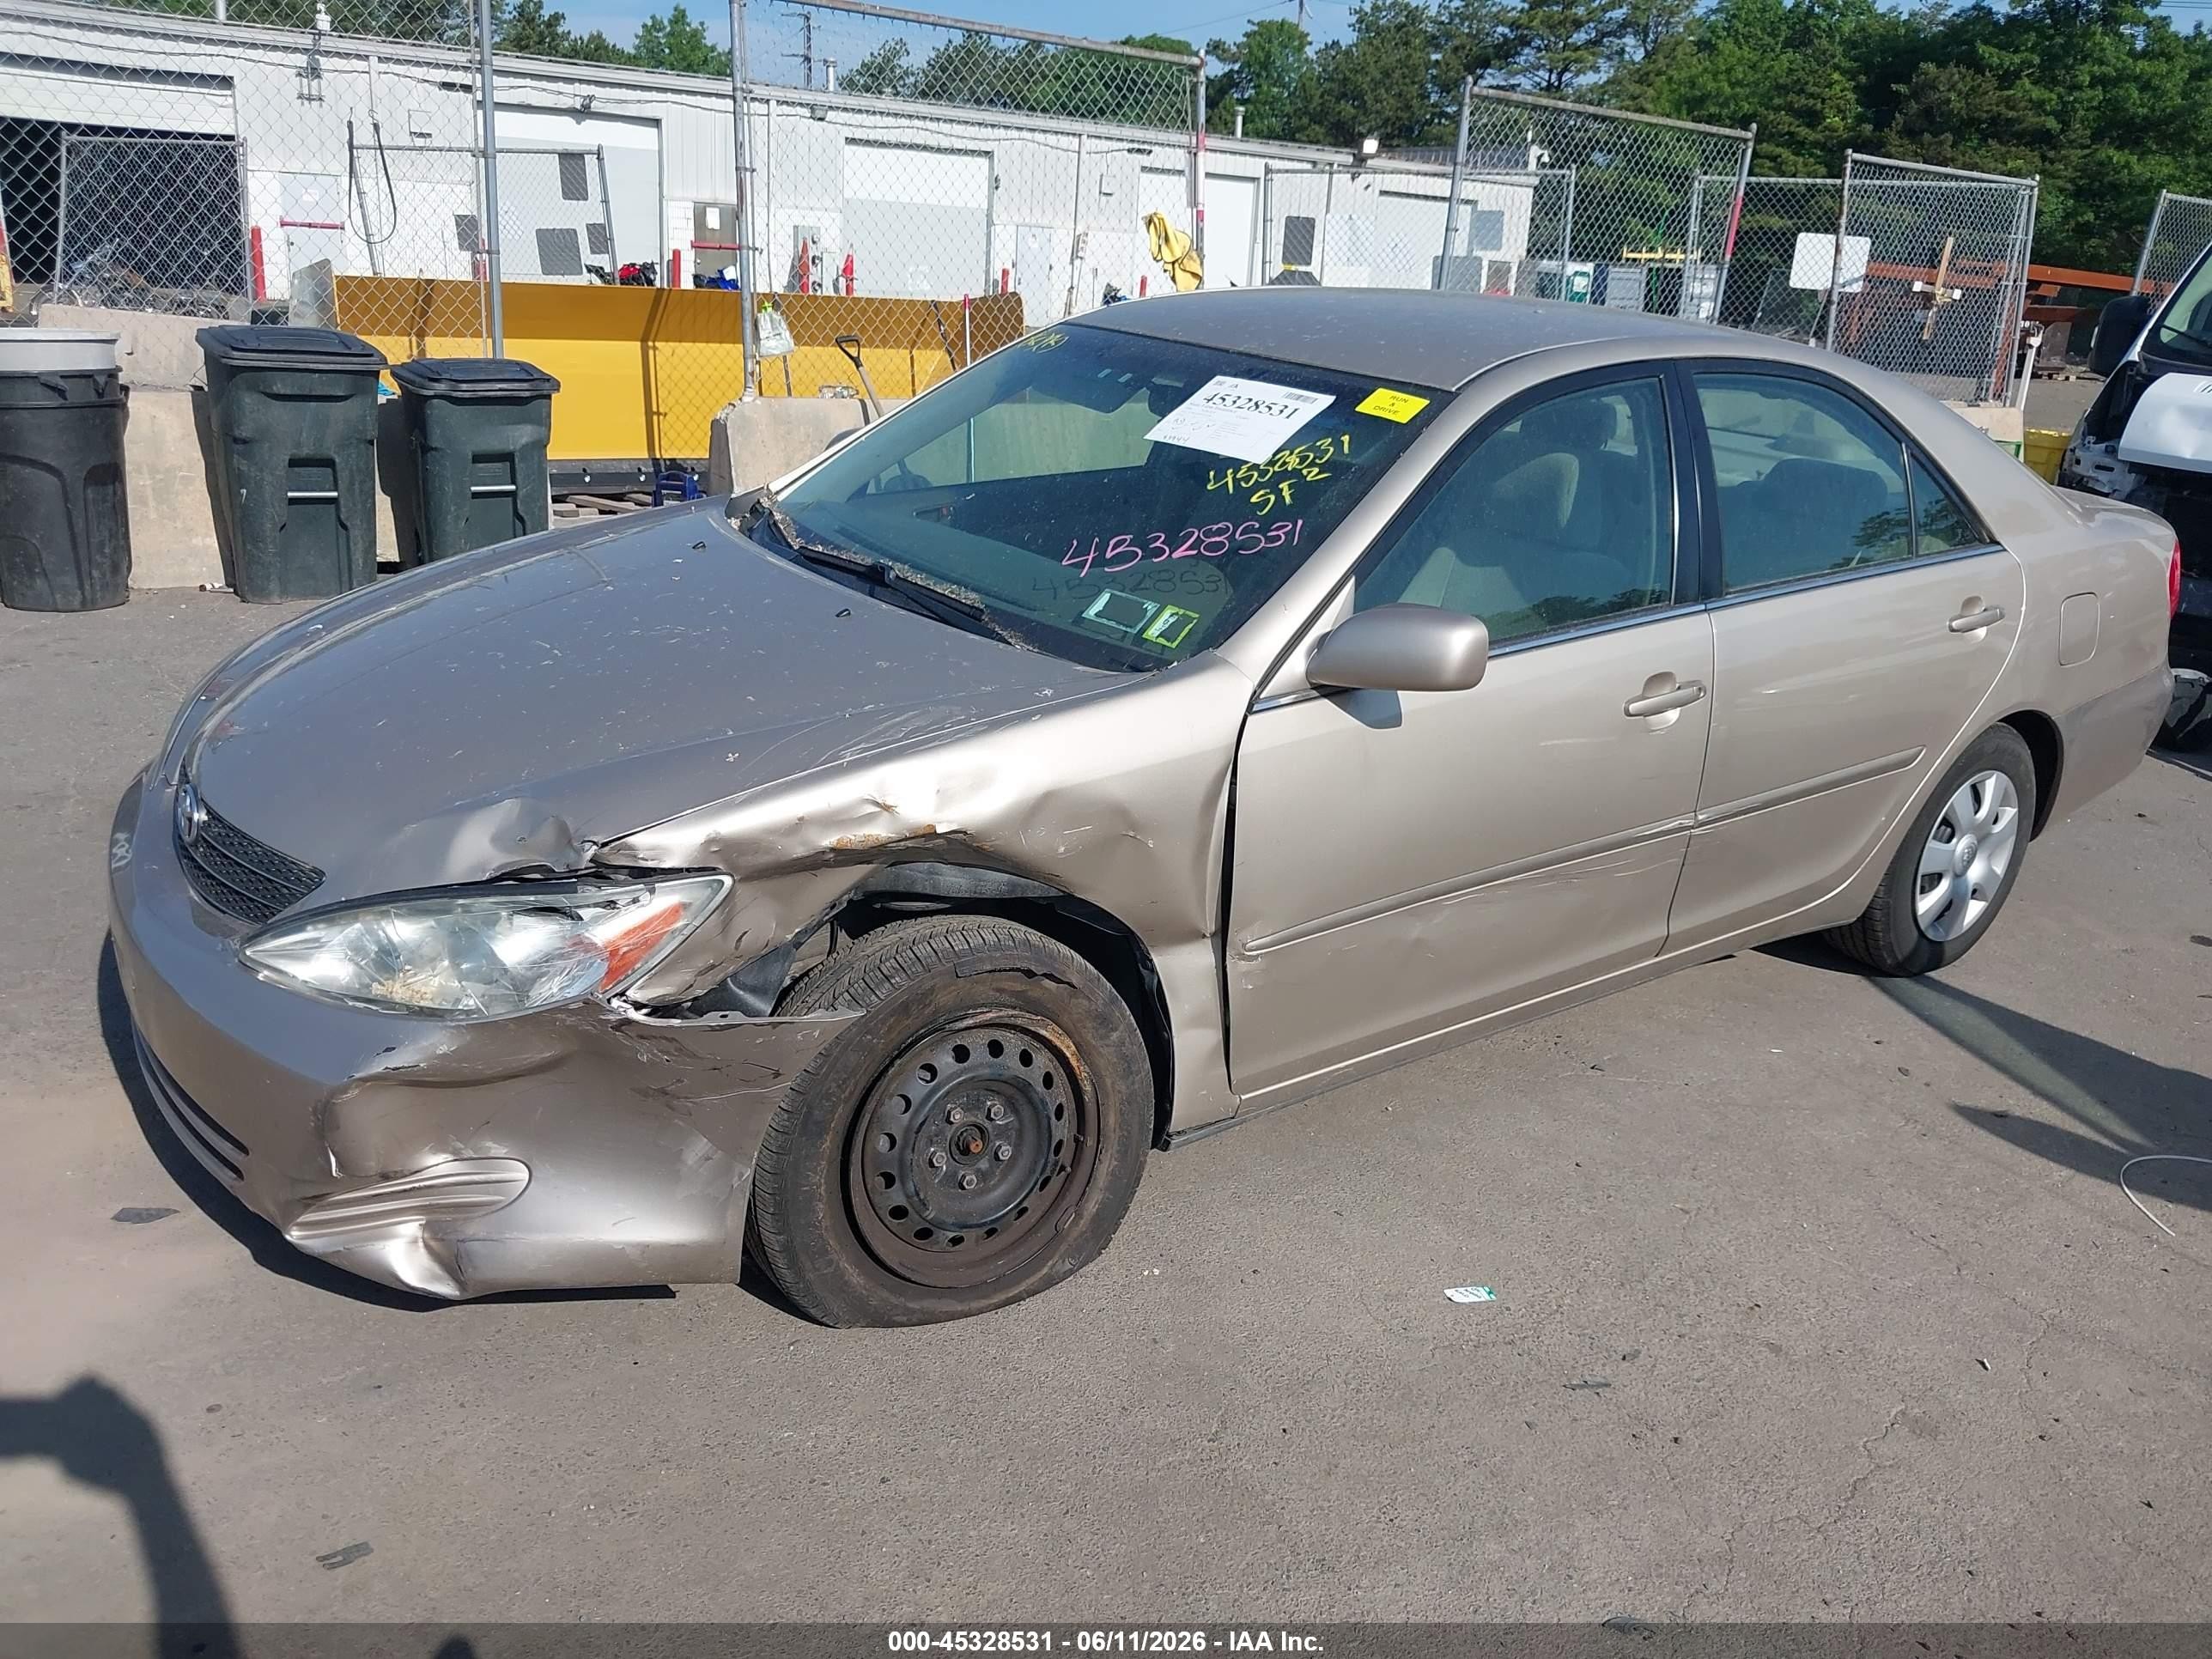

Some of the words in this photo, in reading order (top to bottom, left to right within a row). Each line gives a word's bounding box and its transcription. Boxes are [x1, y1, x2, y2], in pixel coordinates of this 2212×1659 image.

[1202, 392, 1302, 419] 45328531
[1389, 395, 1409, 404] RUN
[1374, 405, 1401, 415] DRIVE
[1061, 520, 1304, 578] 45328531
